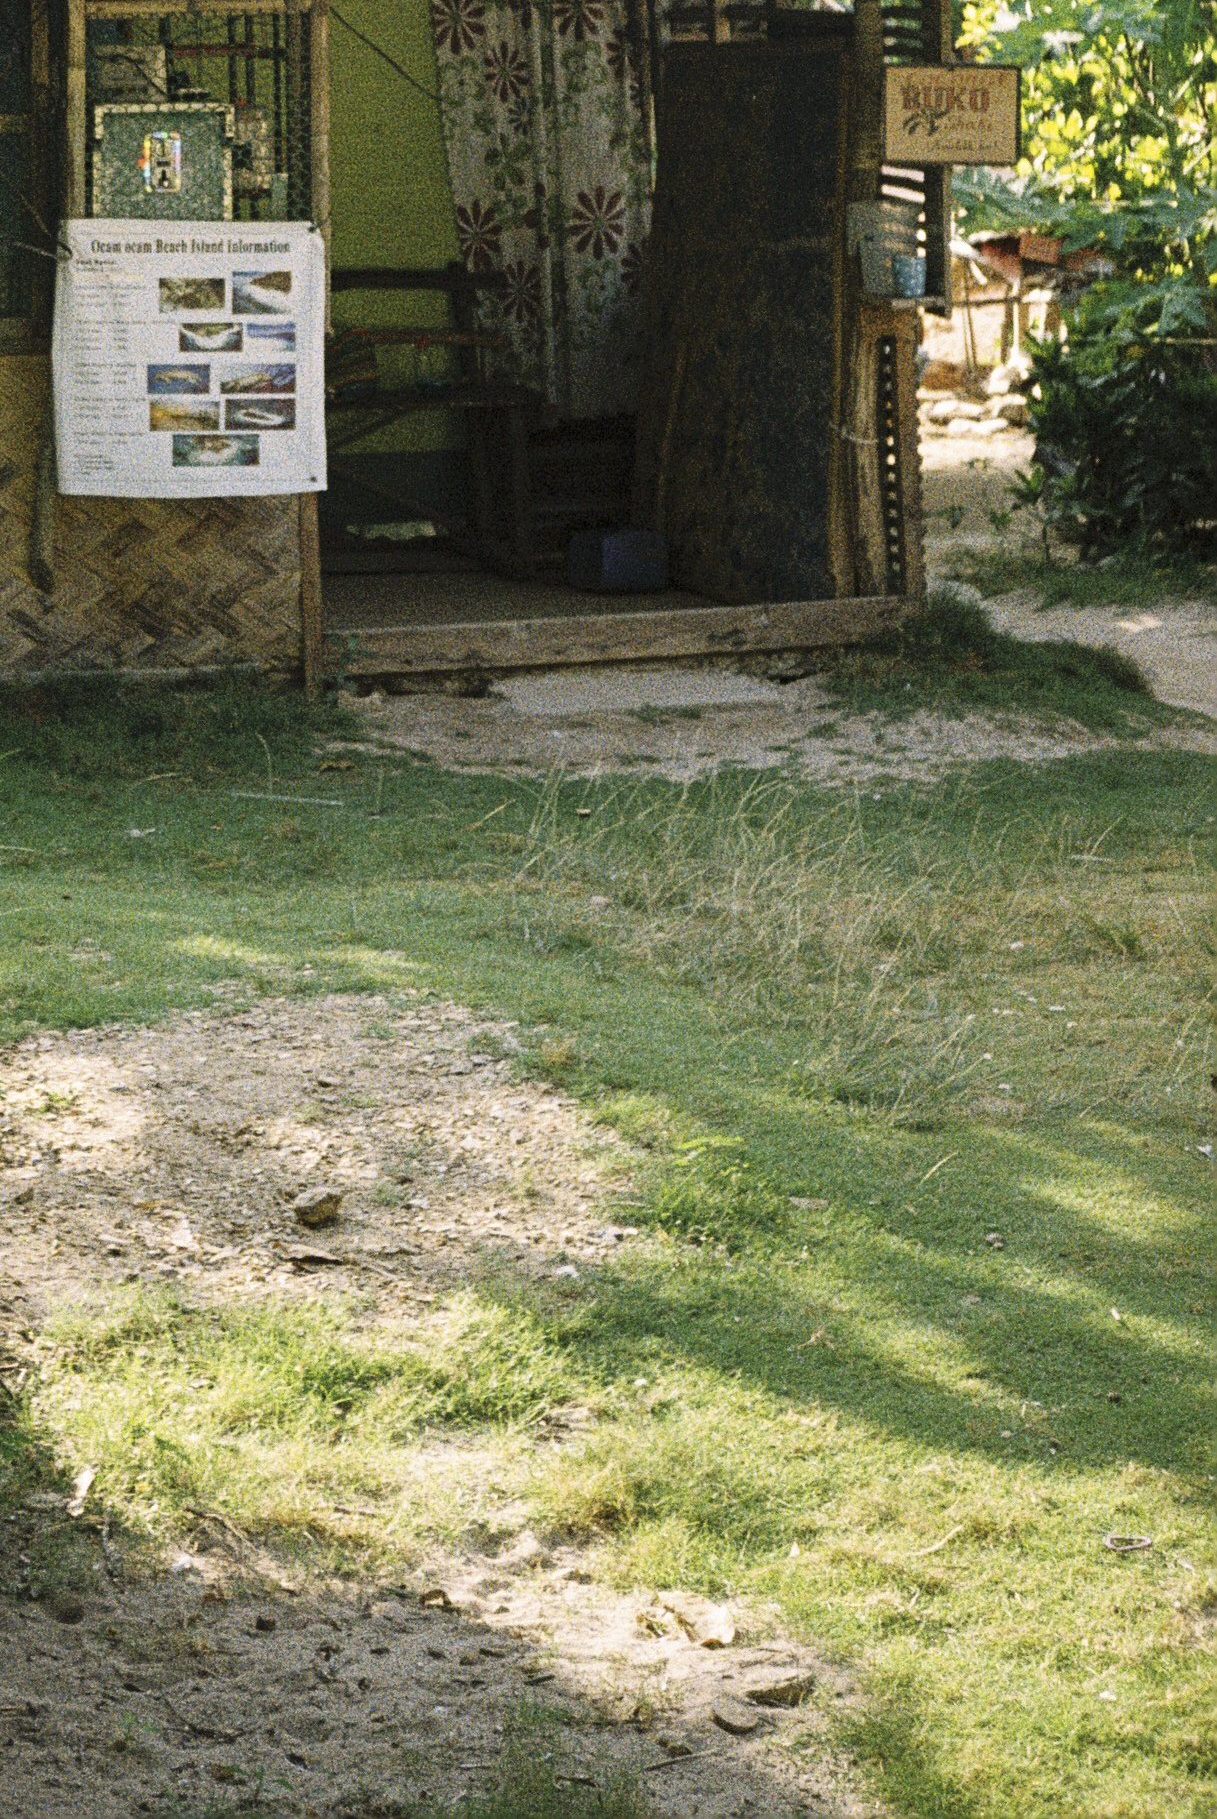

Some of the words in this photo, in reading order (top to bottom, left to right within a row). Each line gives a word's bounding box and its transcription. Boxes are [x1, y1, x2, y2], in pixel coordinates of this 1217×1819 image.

[91, 239, 122, 253] Ocam
[155, 239, 188, 253] Beach
[191, 238, 224, 253] Island
